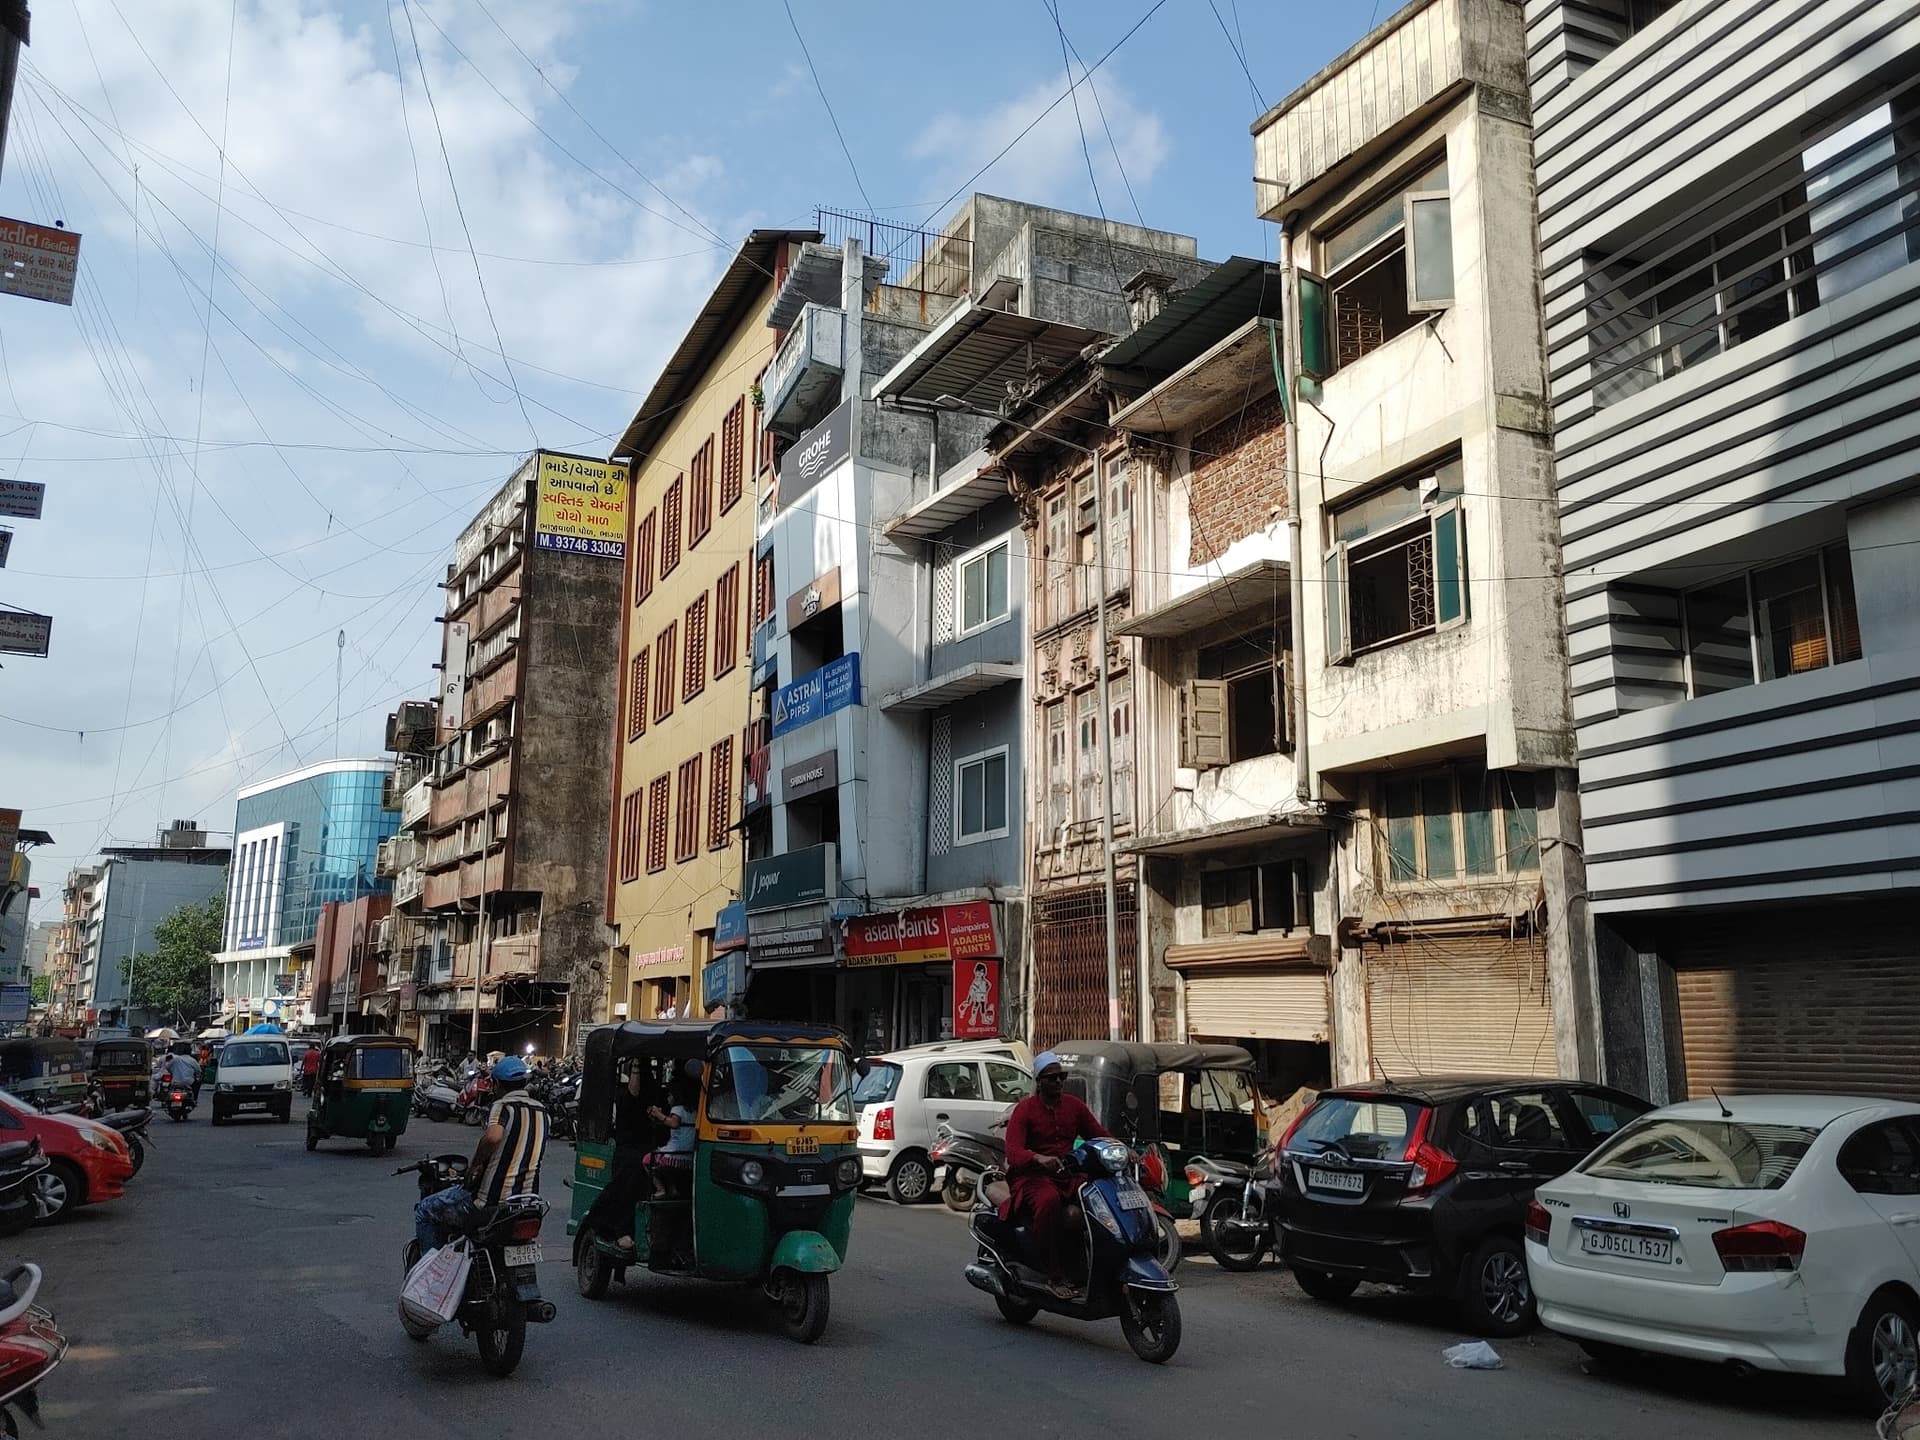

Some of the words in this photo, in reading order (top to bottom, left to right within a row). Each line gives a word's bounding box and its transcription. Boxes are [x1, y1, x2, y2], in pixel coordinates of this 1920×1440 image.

[798, 429, 832, 468] GROHE
[550, 478, 599, 493] આપવાનો
[555, 508, 582, 523] ચોથો
[586, 514, 609, 526] માળ
[539, 533, 553, 547] M.
[555, 535, 588, 551] 93746
[590, 540, 623, 556] 33042
[787, 677, 821, 707] ASTRAL
[790, 701, 810, 720] PIPES
[806, 767, 824, 781] HOUSE
[864, 914, 940, 943] asianpaints
[950, 921, 990, 935] asianpaints
[952, 932, 992, 947] ADARSH
[955, 943, 991, 956] PAINTS
[848, 955, 873, 967] ADARSH
[873, 953, 897, 965] PAINTS
[1591, 1233, 1669, 1258] GJ05CL1537
